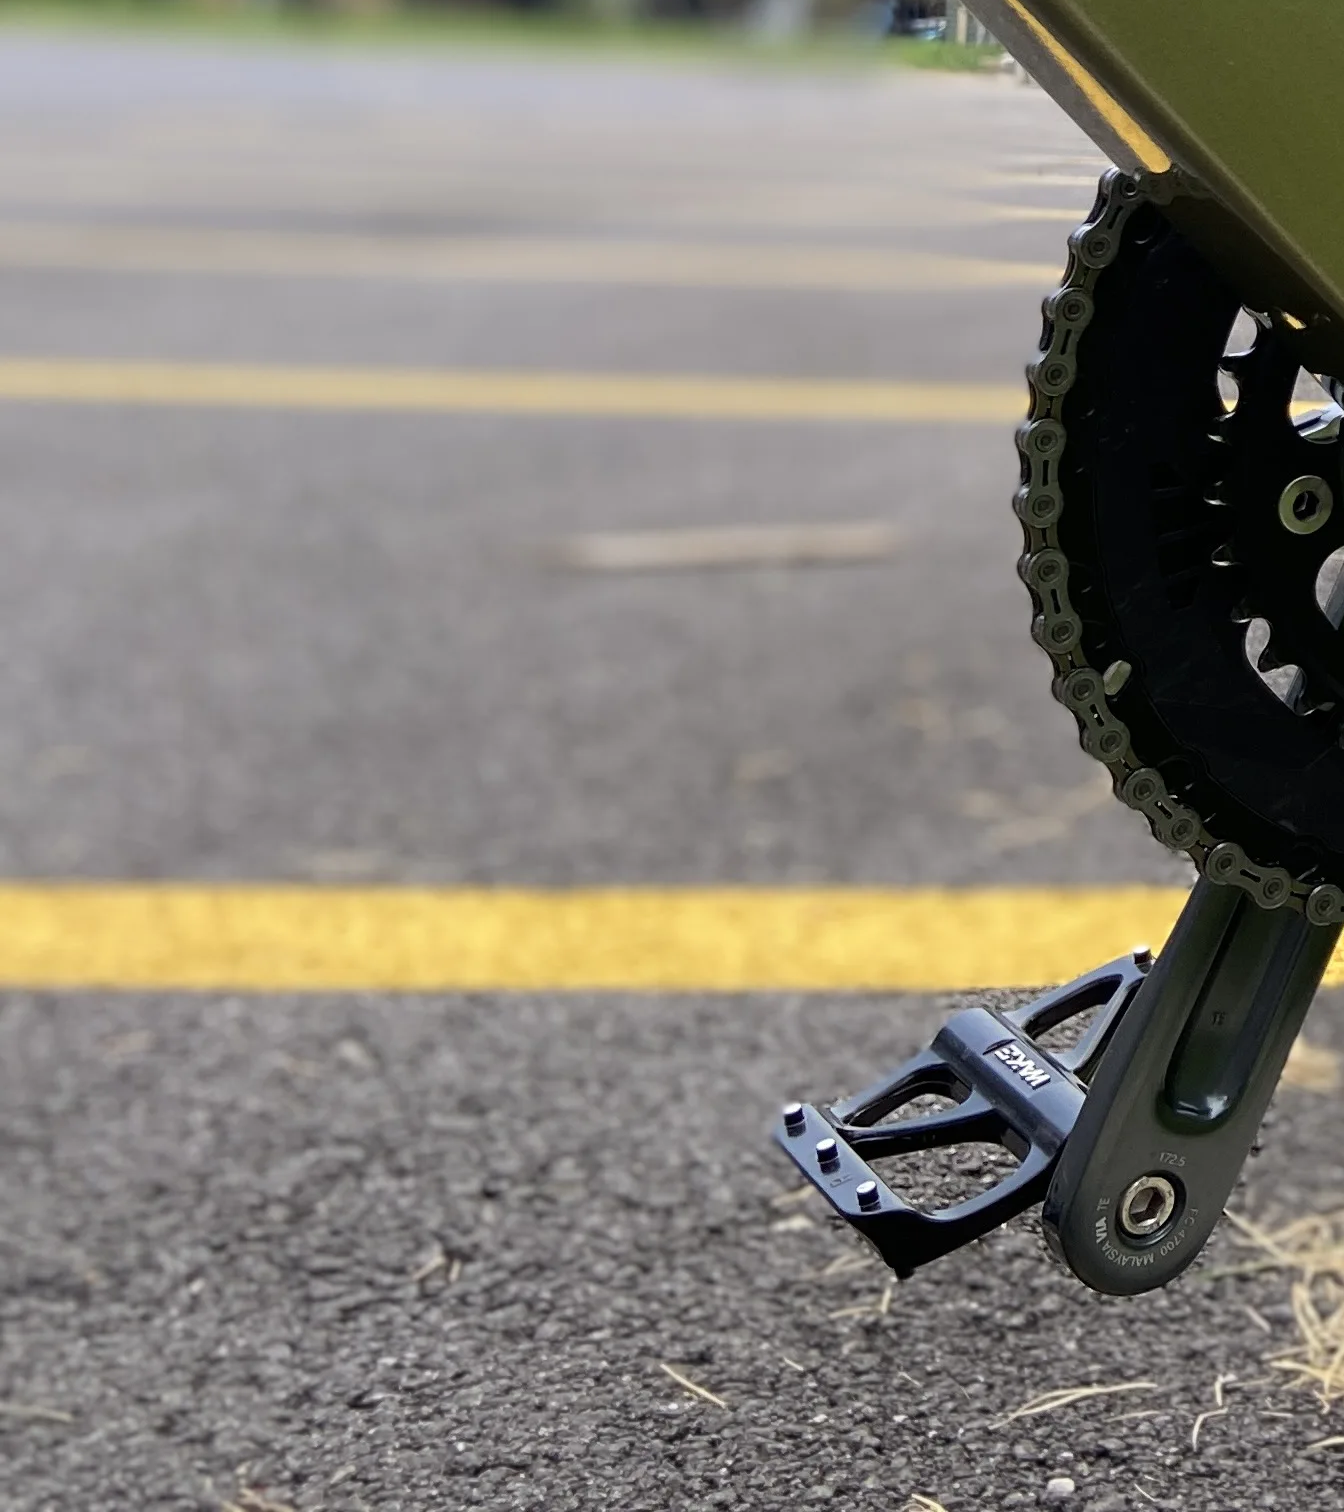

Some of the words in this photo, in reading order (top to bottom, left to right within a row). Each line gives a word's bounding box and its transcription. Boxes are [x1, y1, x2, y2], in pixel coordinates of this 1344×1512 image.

[994, 1044, 1051, 1089] WAKE
[1159, 1151, 1187, 1167] 172.5
[1101, 1240, 1155, 1267] MALAYSIA
